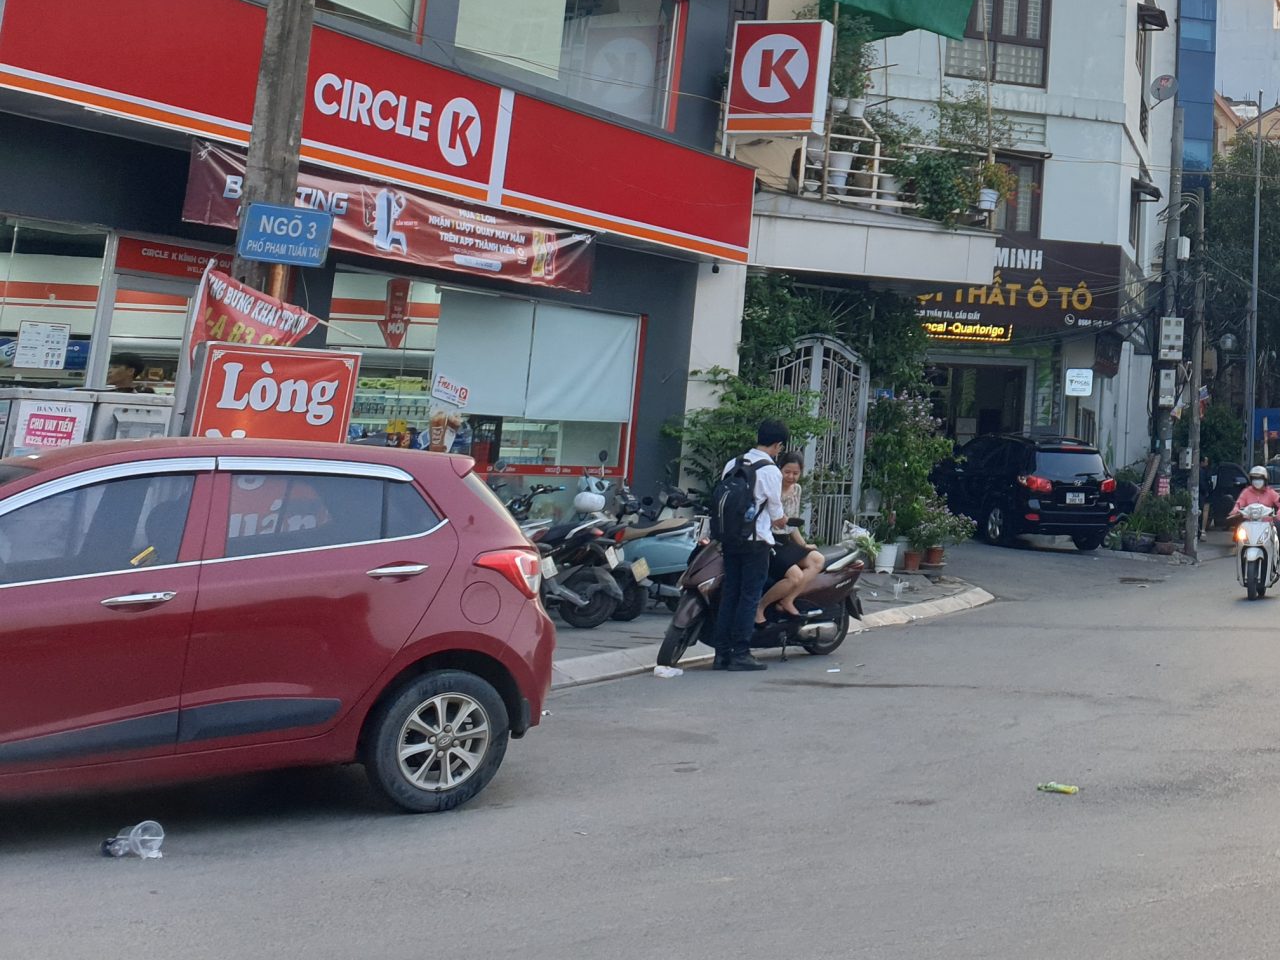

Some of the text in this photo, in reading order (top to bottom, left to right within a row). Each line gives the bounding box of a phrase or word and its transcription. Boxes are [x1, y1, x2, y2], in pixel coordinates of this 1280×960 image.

[313, 72, 479, 166] CIRCLE K
[259, 214, 317, 240] NGÕ 3
[141, 248, 169, 259] CIRCLE
[197, 256, 218, 267] CHO
[246, 236, 266, 253] PHỐ
[265, 243, 286, 257] PHẠM
[994, 246, 1043, 270] MINH
[1027, 276, 1049, 309] Ô
[1057, 280, 1093, 311] TÔ
[216, 360, 339, 426] Lòng
